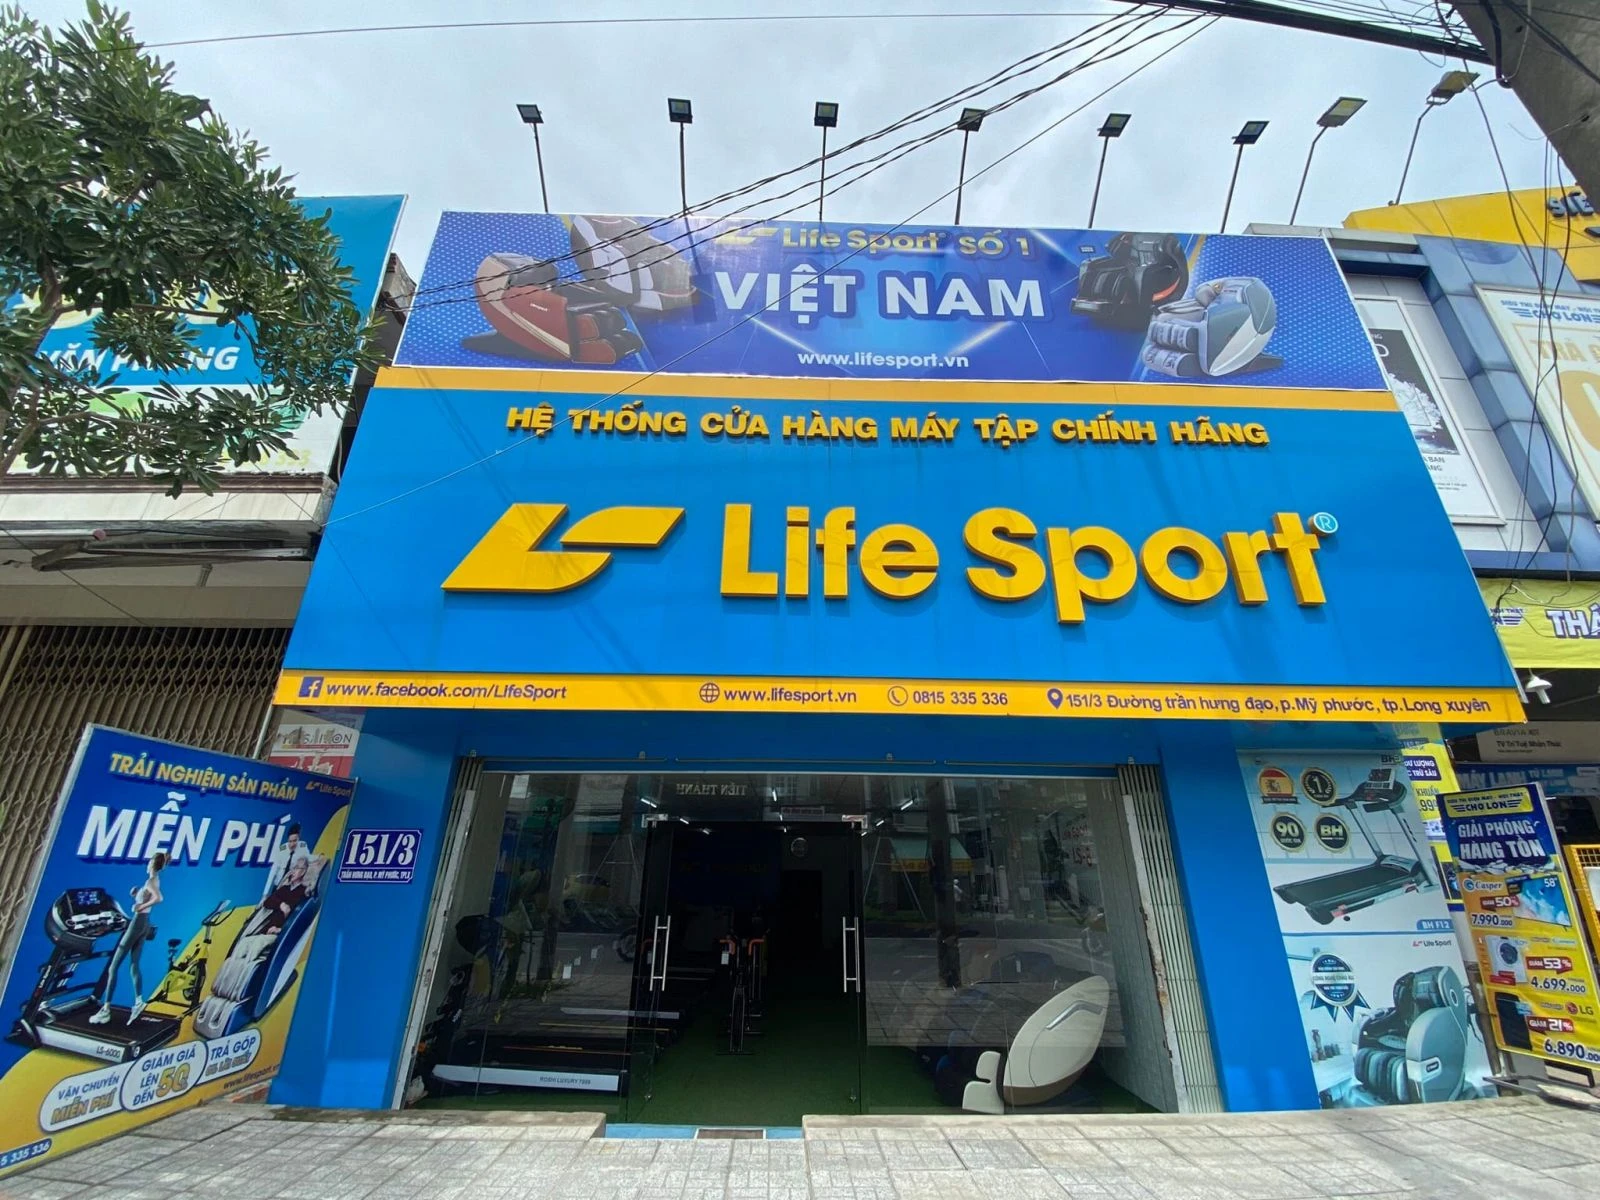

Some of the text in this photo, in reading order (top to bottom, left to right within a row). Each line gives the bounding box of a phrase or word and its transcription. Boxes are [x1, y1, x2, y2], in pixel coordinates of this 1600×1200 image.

[782, 226, 1030, 256] Life Sport SỐ 1
[714, 262, 1046, 326] VIỆT NAM
[110, 346, 241, 371] PNG
[797, 351, 969, 370] www.lifesport.vn
[507, 401, 1270, 448] HỆ THỐNG CỬA HÀNG MÁY TẬP CHÍNH HÃNG
[719, 502, 1328, 624] Life Sport
[325, 682, 568, 702] www.facebook.com/LifeSport
[723, 686, 857, 704] www.lifesport.vn
[912, 689, 1009, 706] 0815 335 336
[1065, 693, 1103, 708] 151/3
[1106, 694, 1162, 712] Đường
[1165, 692, 1197, 710] trần
[1199, 696, 1240, 713] hưng
[1446, 697, 1491, 715] xuyên
[108, 751, 299, 801] TRẢI NGHIỆM SẢN PHẨM
[77, 791, 292, 866] MIỄN PHÍ
[1276, 821, 1300, 837] 90
[1320, 825, 1344, 837] BH
[1458, 818, 1536, 838] GIẢI PHÓNG
[344, 832, 416, 866] 151/3
[1459, 834, 1547, 860] HÀNG TỒN
[1475, 881, 1502, 891] Casper
[1421, 920, 1450, 929] BH F12
[1423, 939, 1452, 948] Life Sport
[1530, 976, 1586, 993] 4.699.000
[1579, 1006, 1594, 1016] LG
[96, 1045, 121, 1059] LS-6000
[210, 1034, 257, 1061] TRẢ GÓP
[141, 1051, 175, 1073] GIẢM
[176, 1044, 197, 1063] GIÁ
[57, 1072, 120, 1101] VẬN CHUYỂN
[140, 1072, 159, 1089] LÊN
[50, 1086, 118, 1126] MIỄN PHÍ
[133, 1088, 155, 1106] ĐẾN
[10, 1147, 30, 1164] 335
[31, 1140, 51, 1155] 336
